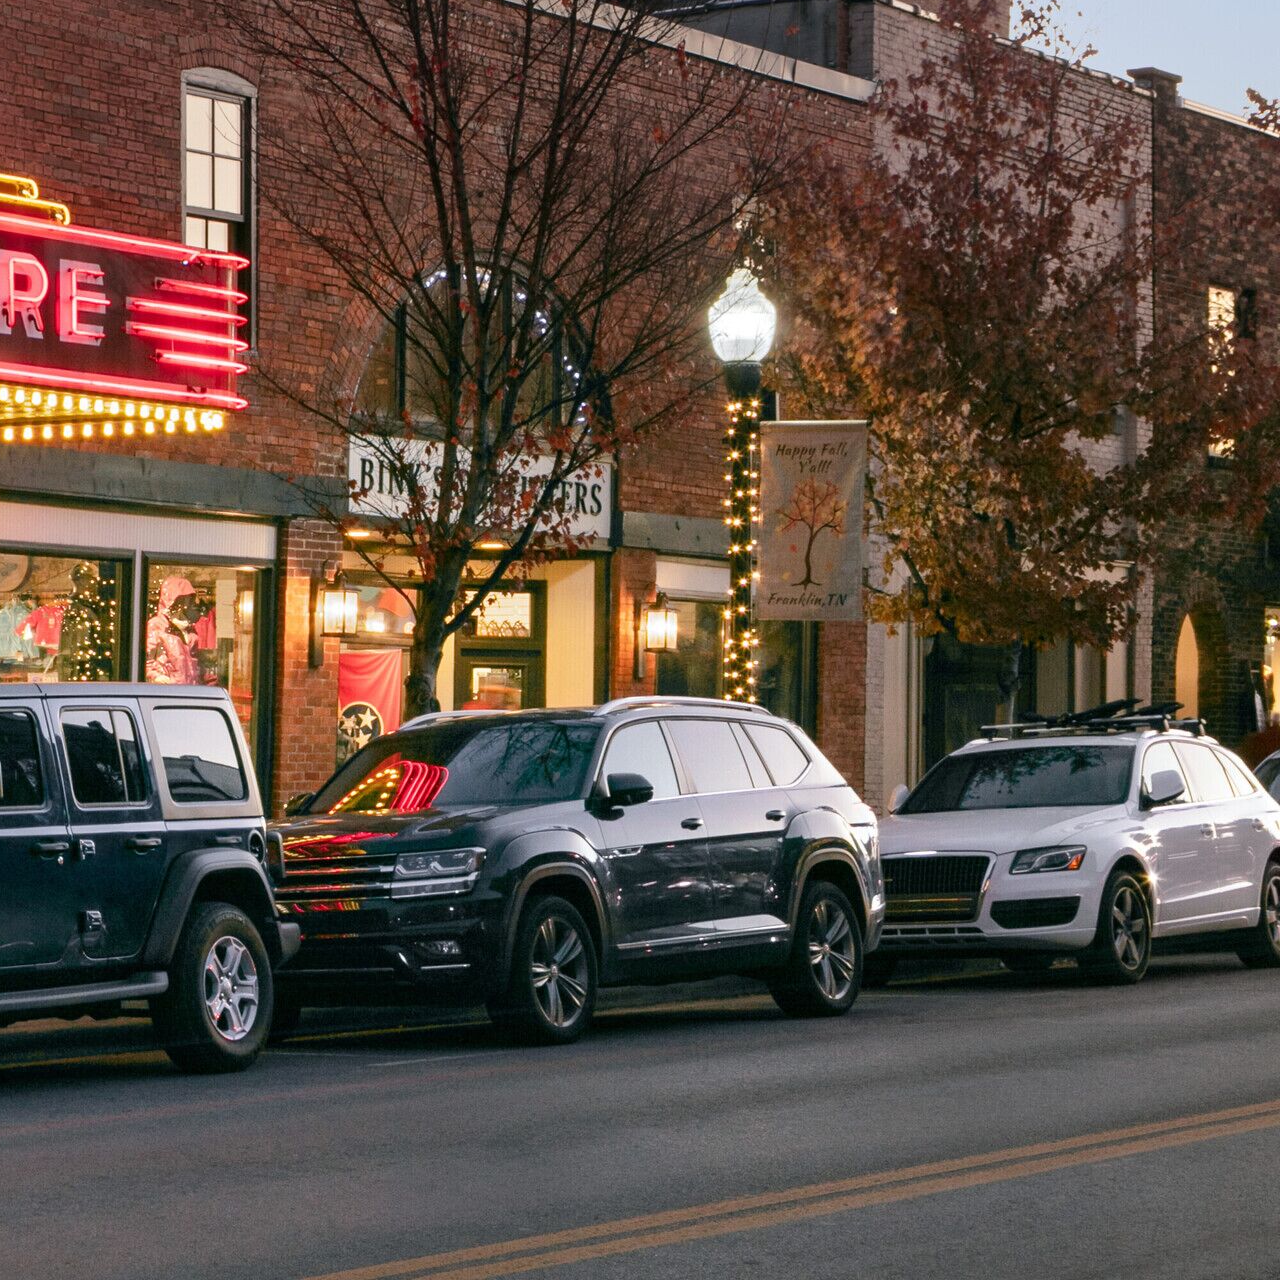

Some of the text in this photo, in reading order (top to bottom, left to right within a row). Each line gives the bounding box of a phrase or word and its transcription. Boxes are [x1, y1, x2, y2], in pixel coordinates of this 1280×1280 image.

[776, 442, 848, 461] Happy Fall,
[799, 460, 833, 474] Y'all!
